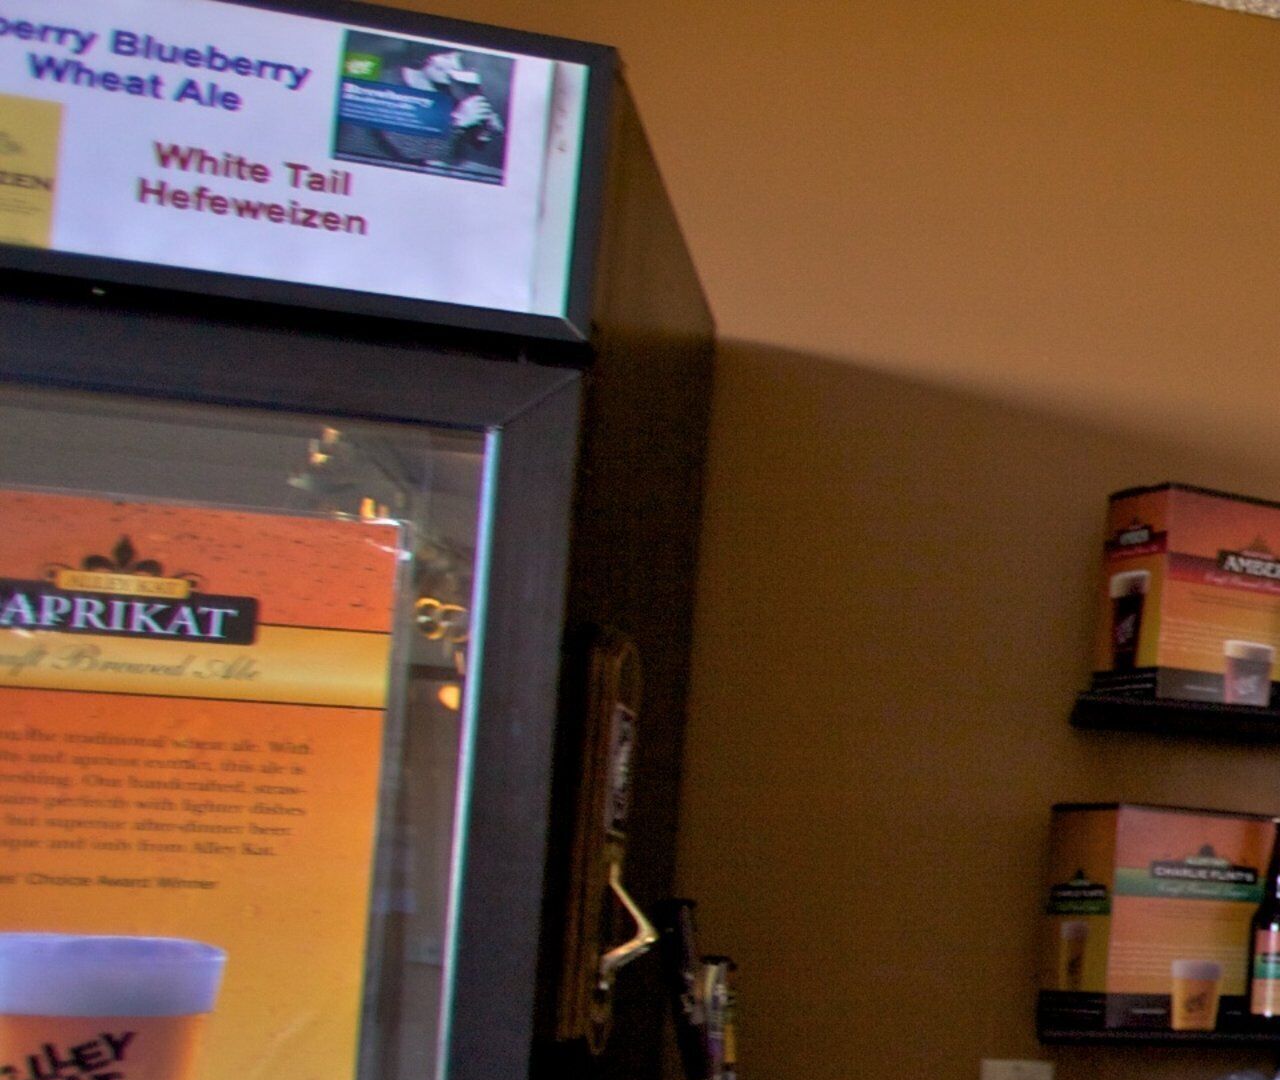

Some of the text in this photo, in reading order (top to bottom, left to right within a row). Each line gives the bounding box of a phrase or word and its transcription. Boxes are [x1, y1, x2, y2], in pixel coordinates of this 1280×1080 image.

[28, 52, 243, 111] Wheat Ale
[110, 29, 312, 90] Blueberry
[153, 140, 351, 197] White Tail
[136, 178, 368, 236] Hefeweizen
[0, 592, 240, 639] APRIKAT
